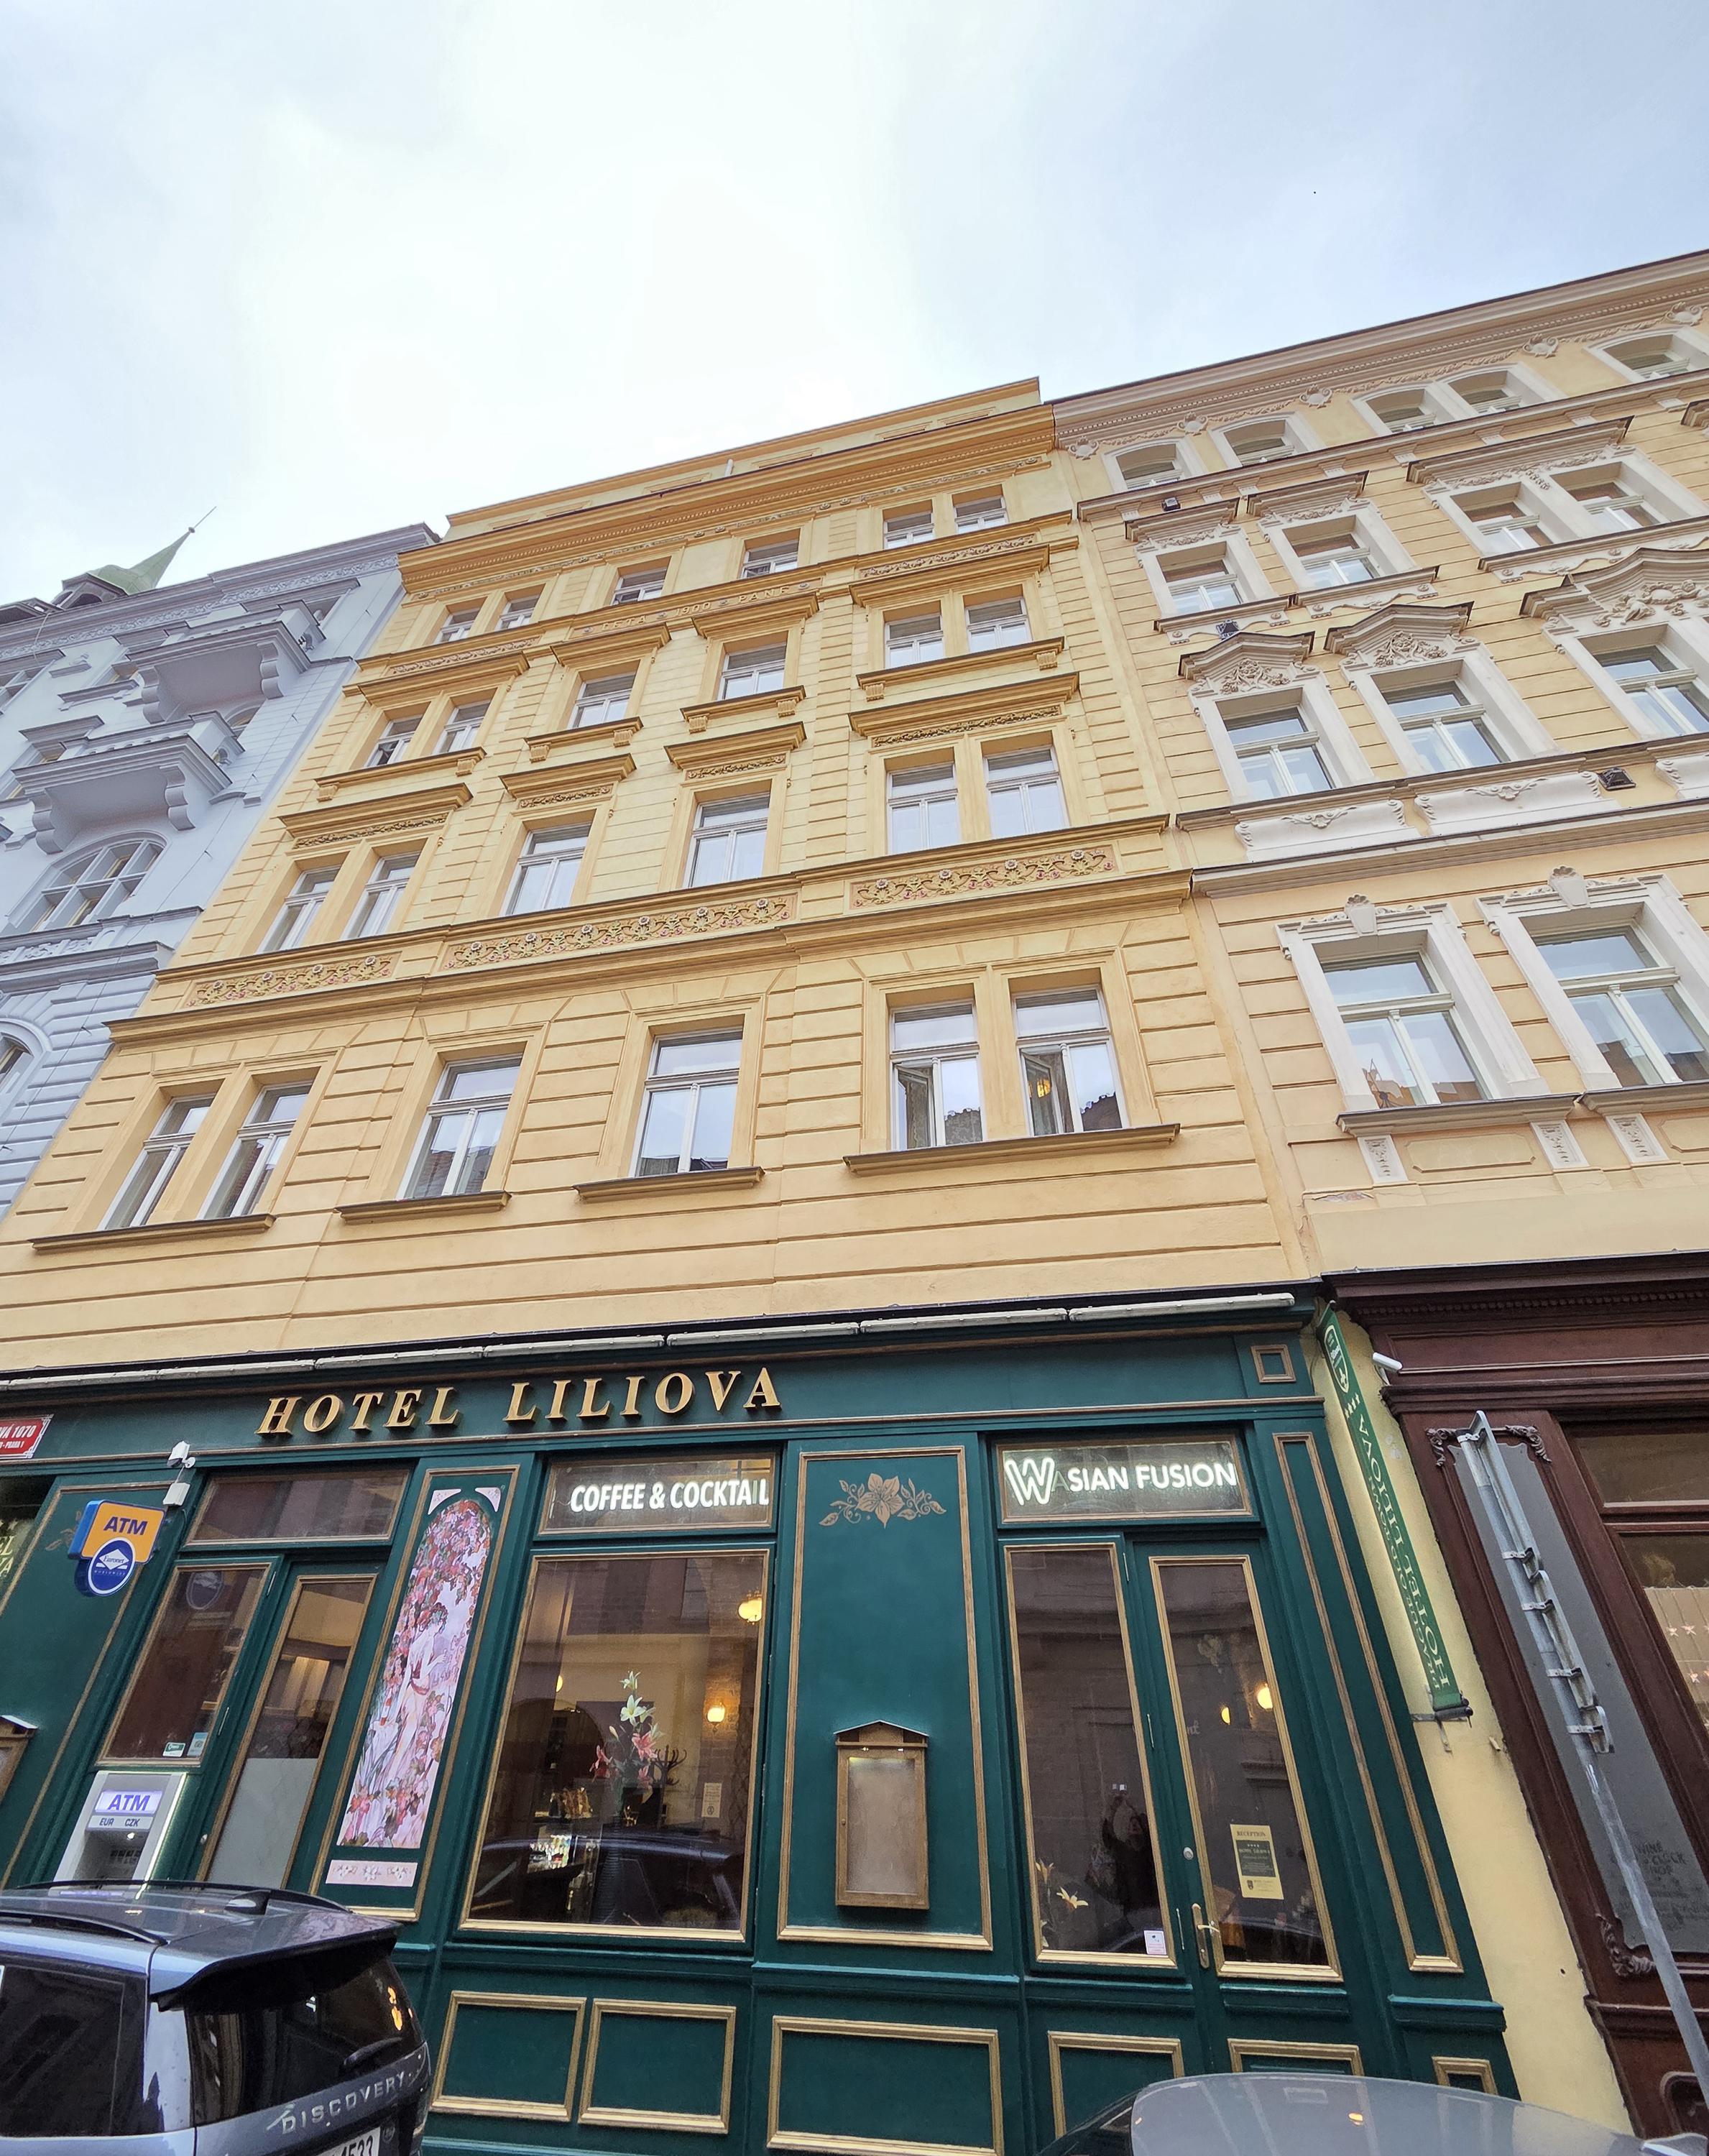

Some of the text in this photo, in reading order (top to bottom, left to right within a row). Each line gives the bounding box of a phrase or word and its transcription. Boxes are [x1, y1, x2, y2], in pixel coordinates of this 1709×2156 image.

[676, 602, 711, 616] 1900
[255, 1367, 782, 1435] HOTEL LILIOVA
[11, 1425, 37, 1437] 1070
[1136, 1462, 1237, 1490] FUSION
[570, 1478, 769, 1512] COFFEE & COCKTAIL
[103, 1516, 148, 1535] ATM
[103, 1555, 124, 1564] Euronet
[1359, 1414, 1450, 1686] HOTEL LILIOVA
[1368, 1475, 1440, 1689] PRAGUE OLD TOWN
[108, 1795, 150, 1811] ATM
[124, 1818, 140, 1827] CZK
[282, 2070, 405, 2135] DISCOVERY
